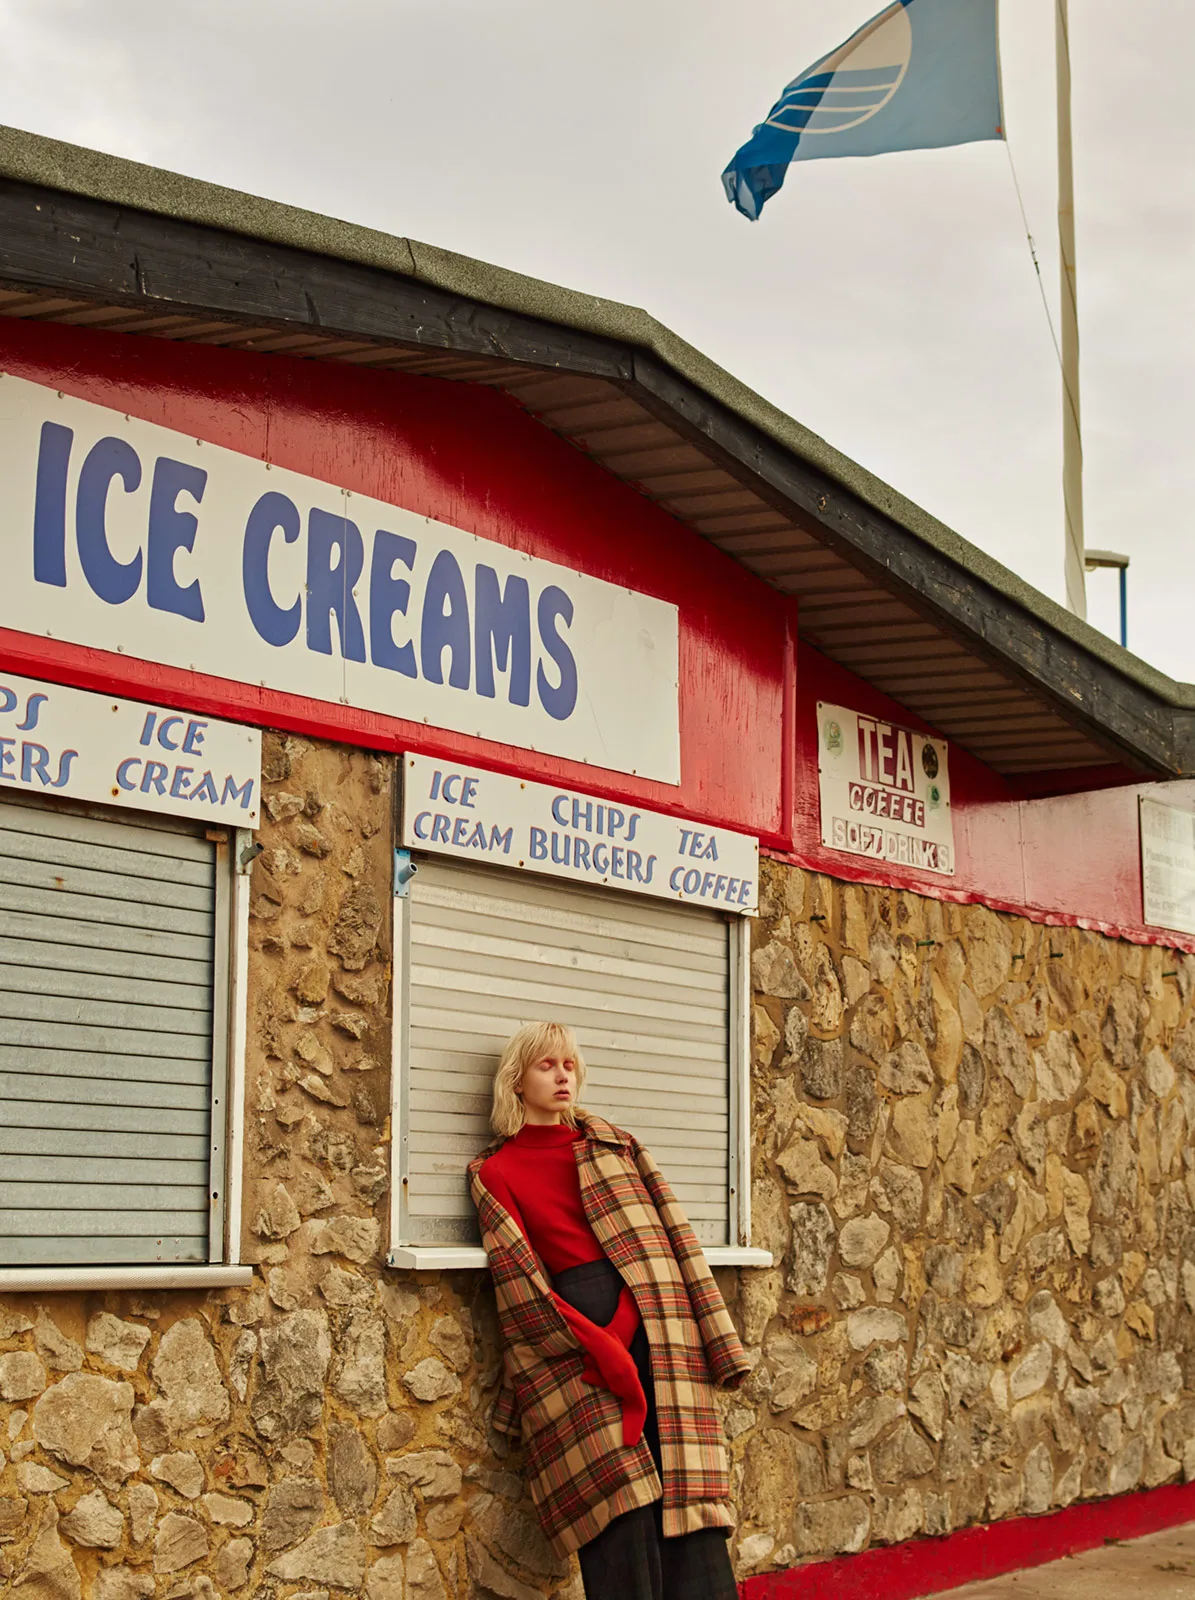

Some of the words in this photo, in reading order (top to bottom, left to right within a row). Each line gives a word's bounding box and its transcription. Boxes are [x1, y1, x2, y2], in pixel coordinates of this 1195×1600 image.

[33, 421, 208, 623] ICE
[241, 490, 579, 721] CREAMS
[139, 711, 208, 756] ICE
[858, 718, 915, 793] TEA
[116, 757, 254, 809] CREAM
[429, 770, 480, 809] ICE
[413, 811, 513, 854] CREAM
[551, 794, 641, 842] CHIPS
[529, 825, 658, 884] BURGERS
[678, 828, 719, 862] TEA
[886, 831, 950, 872] DRINKS
[669, 866, 753, 906] COFFEE
